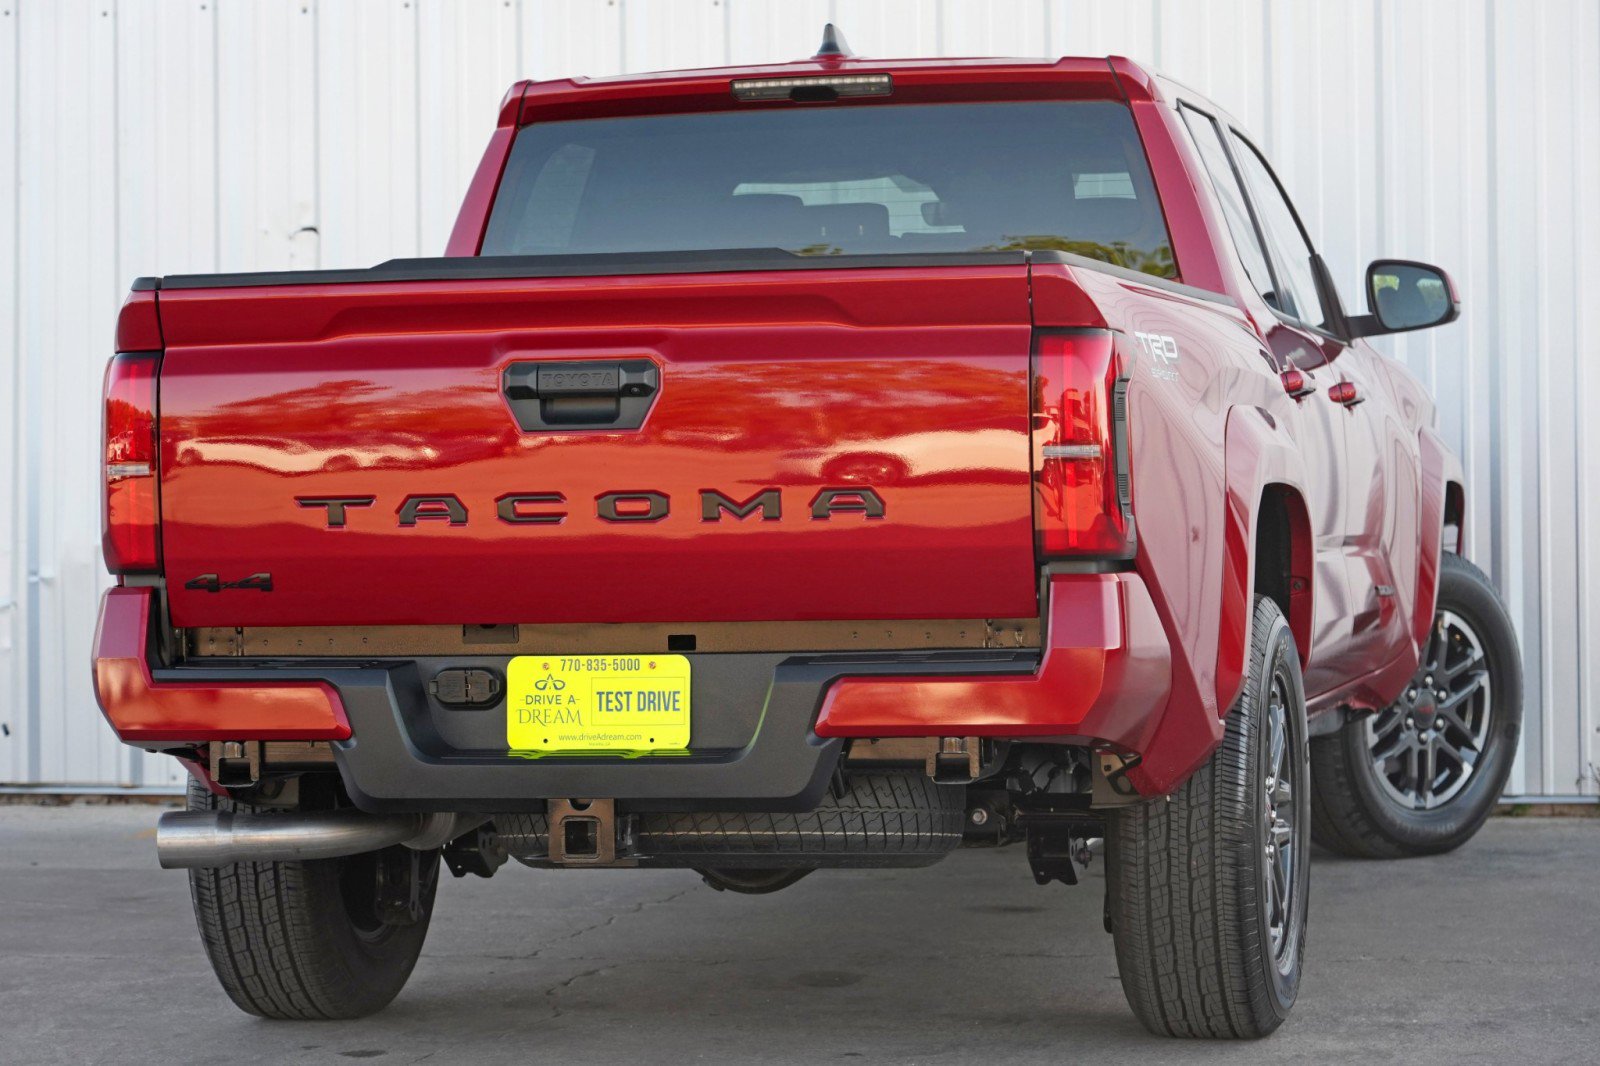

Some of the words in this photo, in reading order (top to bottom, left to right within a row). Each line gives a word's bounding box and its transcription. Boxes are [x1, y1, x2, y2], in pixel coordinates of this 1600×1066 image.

[1134, 331, 1178, 365] TRD
[542, 371, 616, 388] TOYOTA
[294, 487, 887, 529] TACOMA
[560, 658, 641, 672] 770-835-5000
[525, 694, 562, 705] DRIVE
[567, 694, 576, 705] A
[596, 691, 632, 712] TEST
[637, 690, 681, 712] DRIVE
[516, 707, 584, 726] DREAM
[558, 732, 643, 741] www.driveAdream.com
